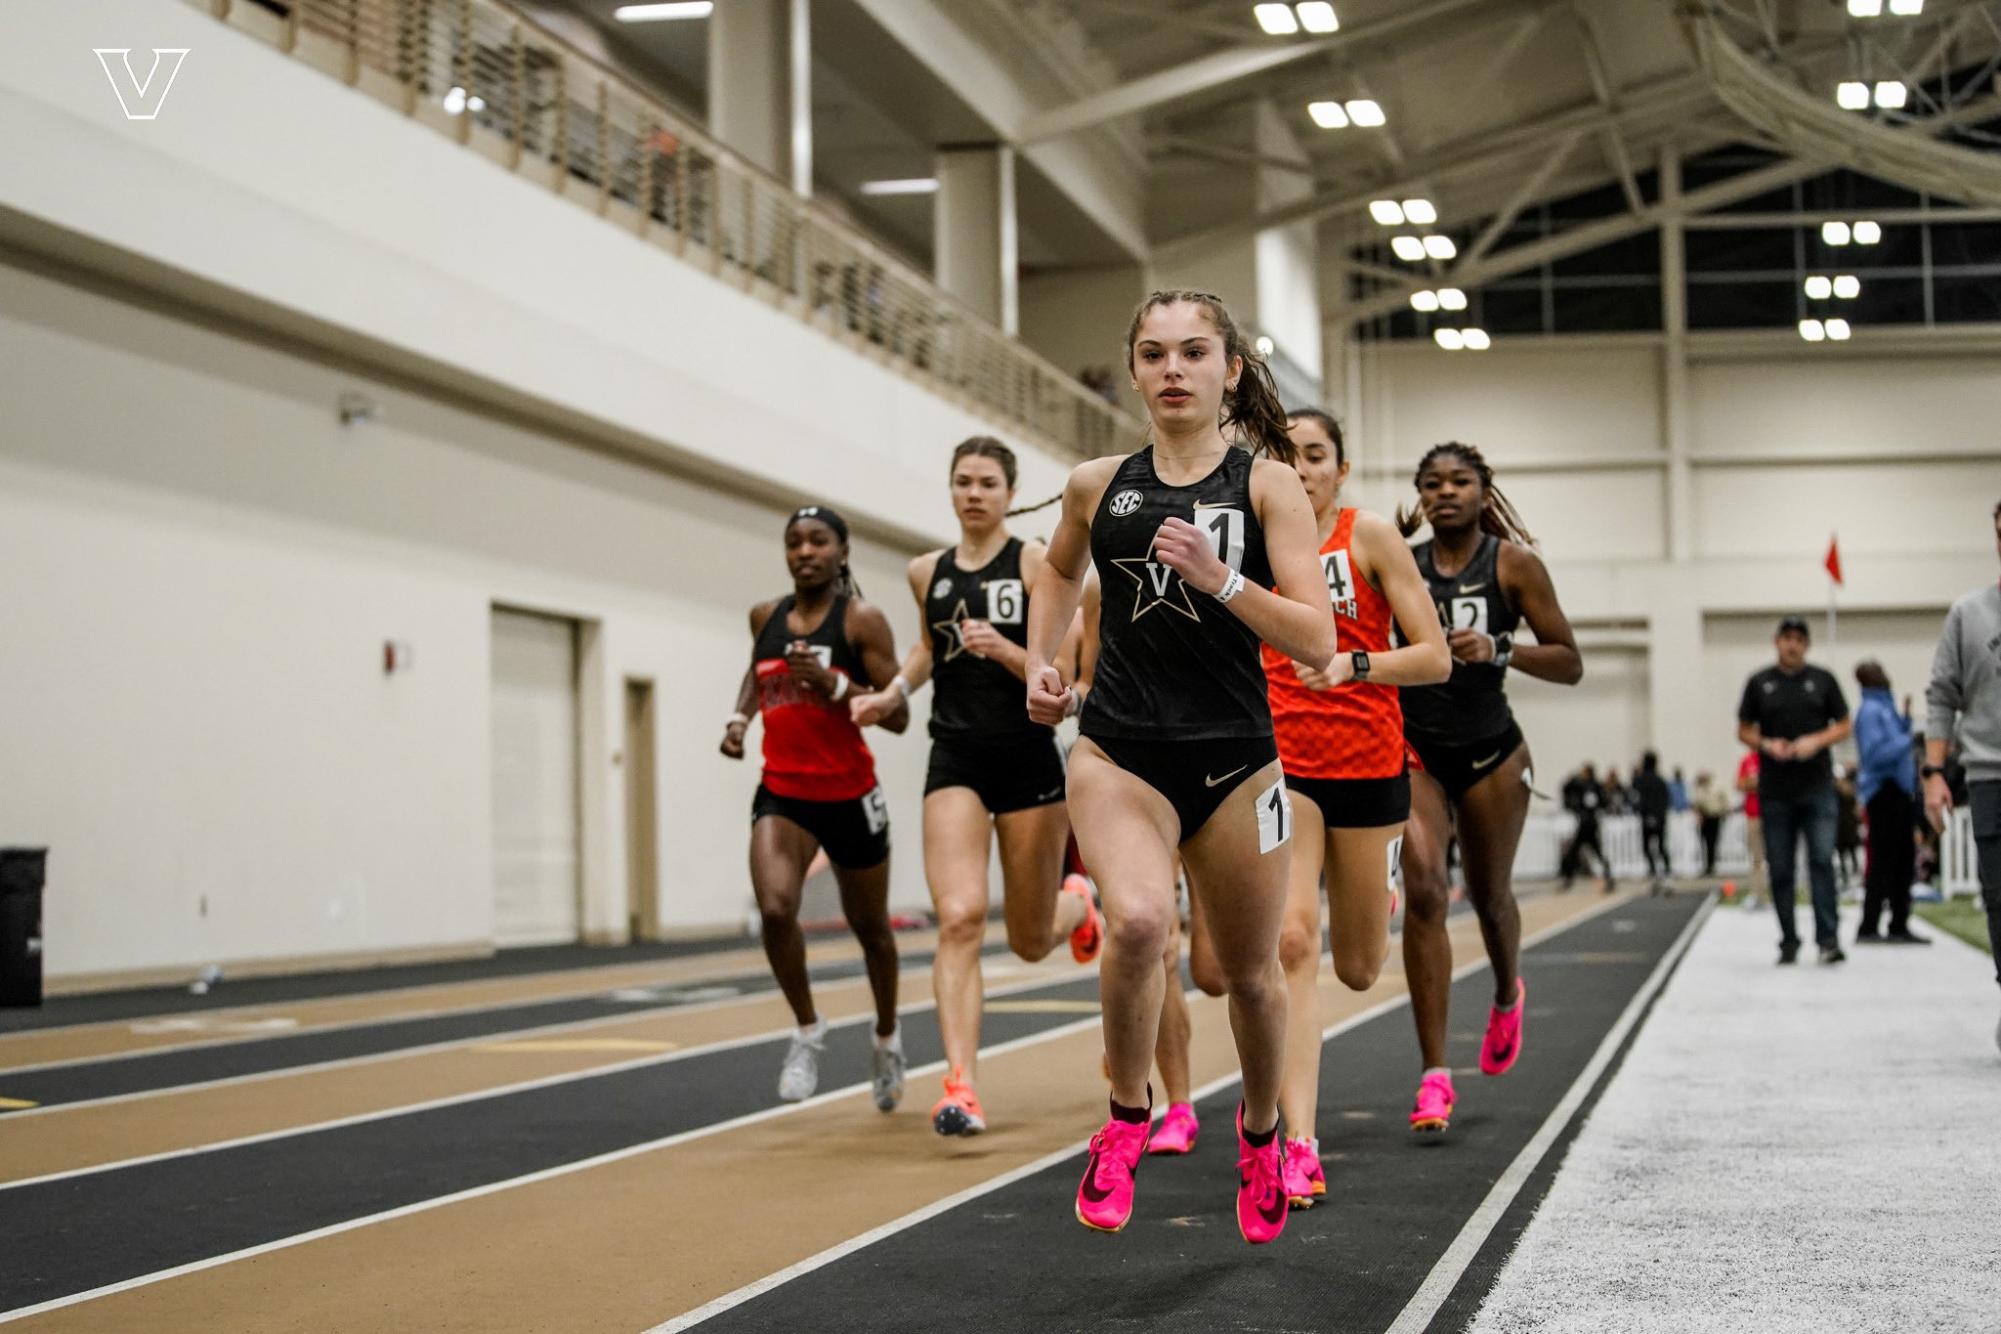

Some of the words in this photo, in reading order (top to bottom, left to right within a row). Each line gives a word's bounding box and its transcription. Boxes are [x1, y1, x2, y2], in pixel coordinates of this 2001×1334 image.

[1111, 491, 1141, 514] SEC
[1208, 513, 1229, 564] 1
[1146, 562, 1173, 597] V
[1325, 556, 1346, 597] 4
[997, 584, 1014, 619] 6
[1461, 602, 1478, 628] 2
[1268, 787, 1284, 842] 1
